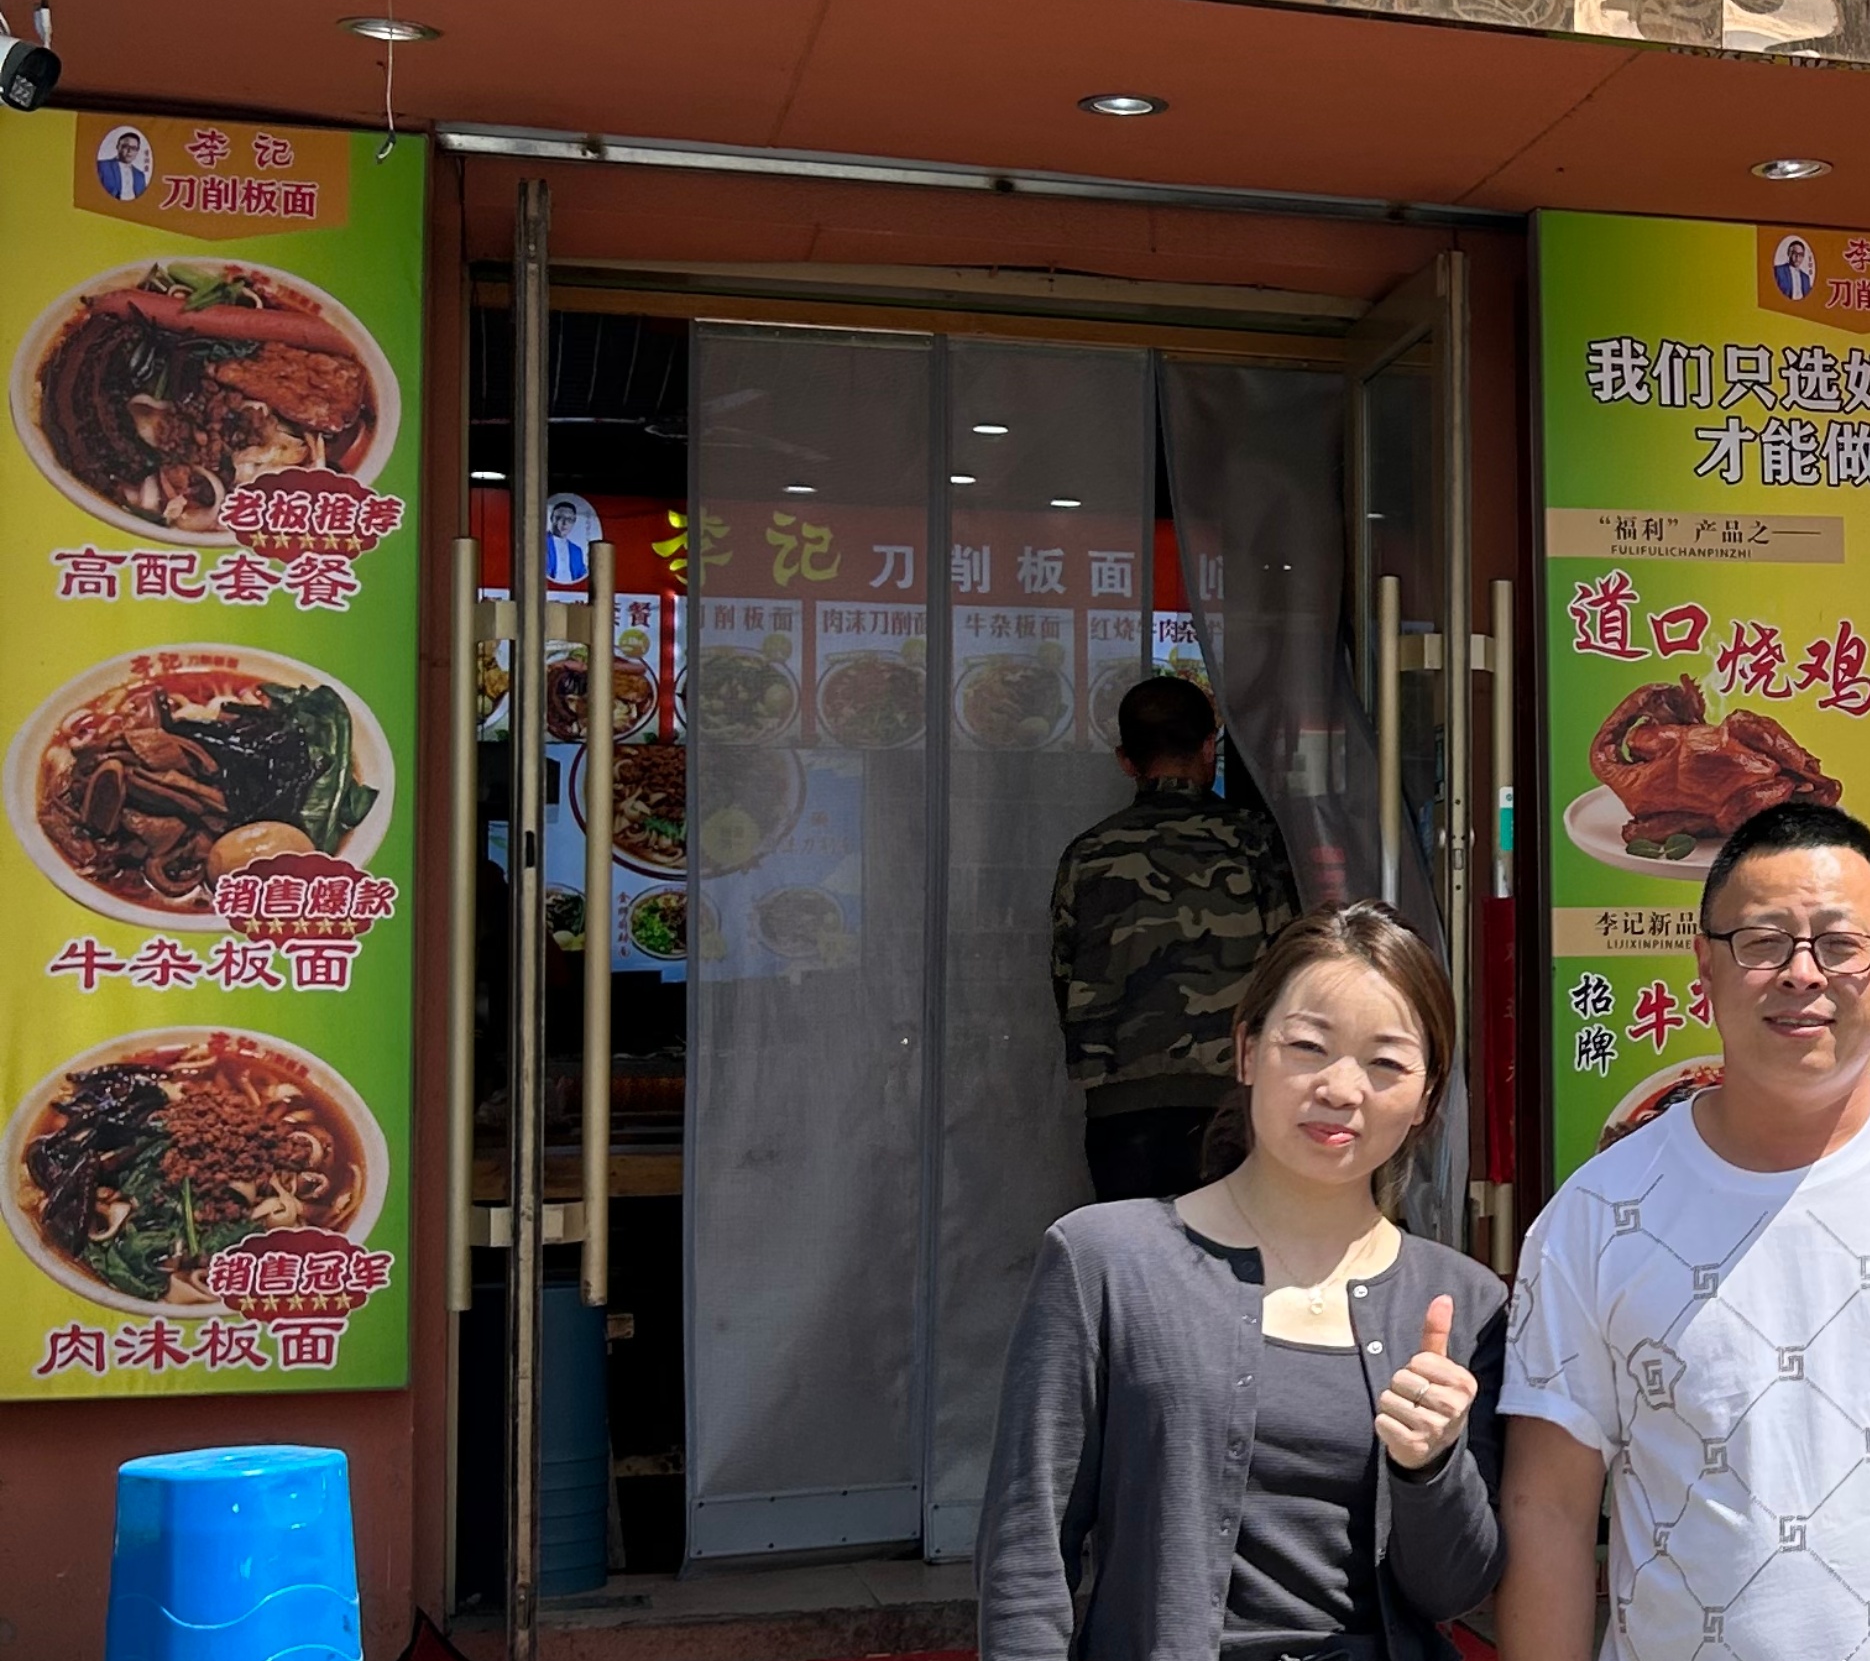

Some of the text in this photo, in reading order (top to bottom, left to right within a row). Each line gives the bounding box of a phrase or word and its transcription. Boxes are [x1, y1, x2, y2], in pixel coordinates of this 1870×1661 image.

[187, 130, 294, 169] 李记
[161, 176, 319, 218] 刀削板面
[219, 488, 403, 535] 老板推荐
[869, 544, 1135, 597] 刀削板面
[1611, 545, 1751, 559] FULIFULICHANPINZHI
[54, 547, 360, 609] 高配套餐
[216, 875, 397, 917] 销售爆款
[48, 937, 361, 991] 牛杂板面
[1569, 972, 1618, 1077] 招牌
[207, 1252, 393, 1294] 销售冠军
[34, 1316, 346, 1378] 肉沫板面
